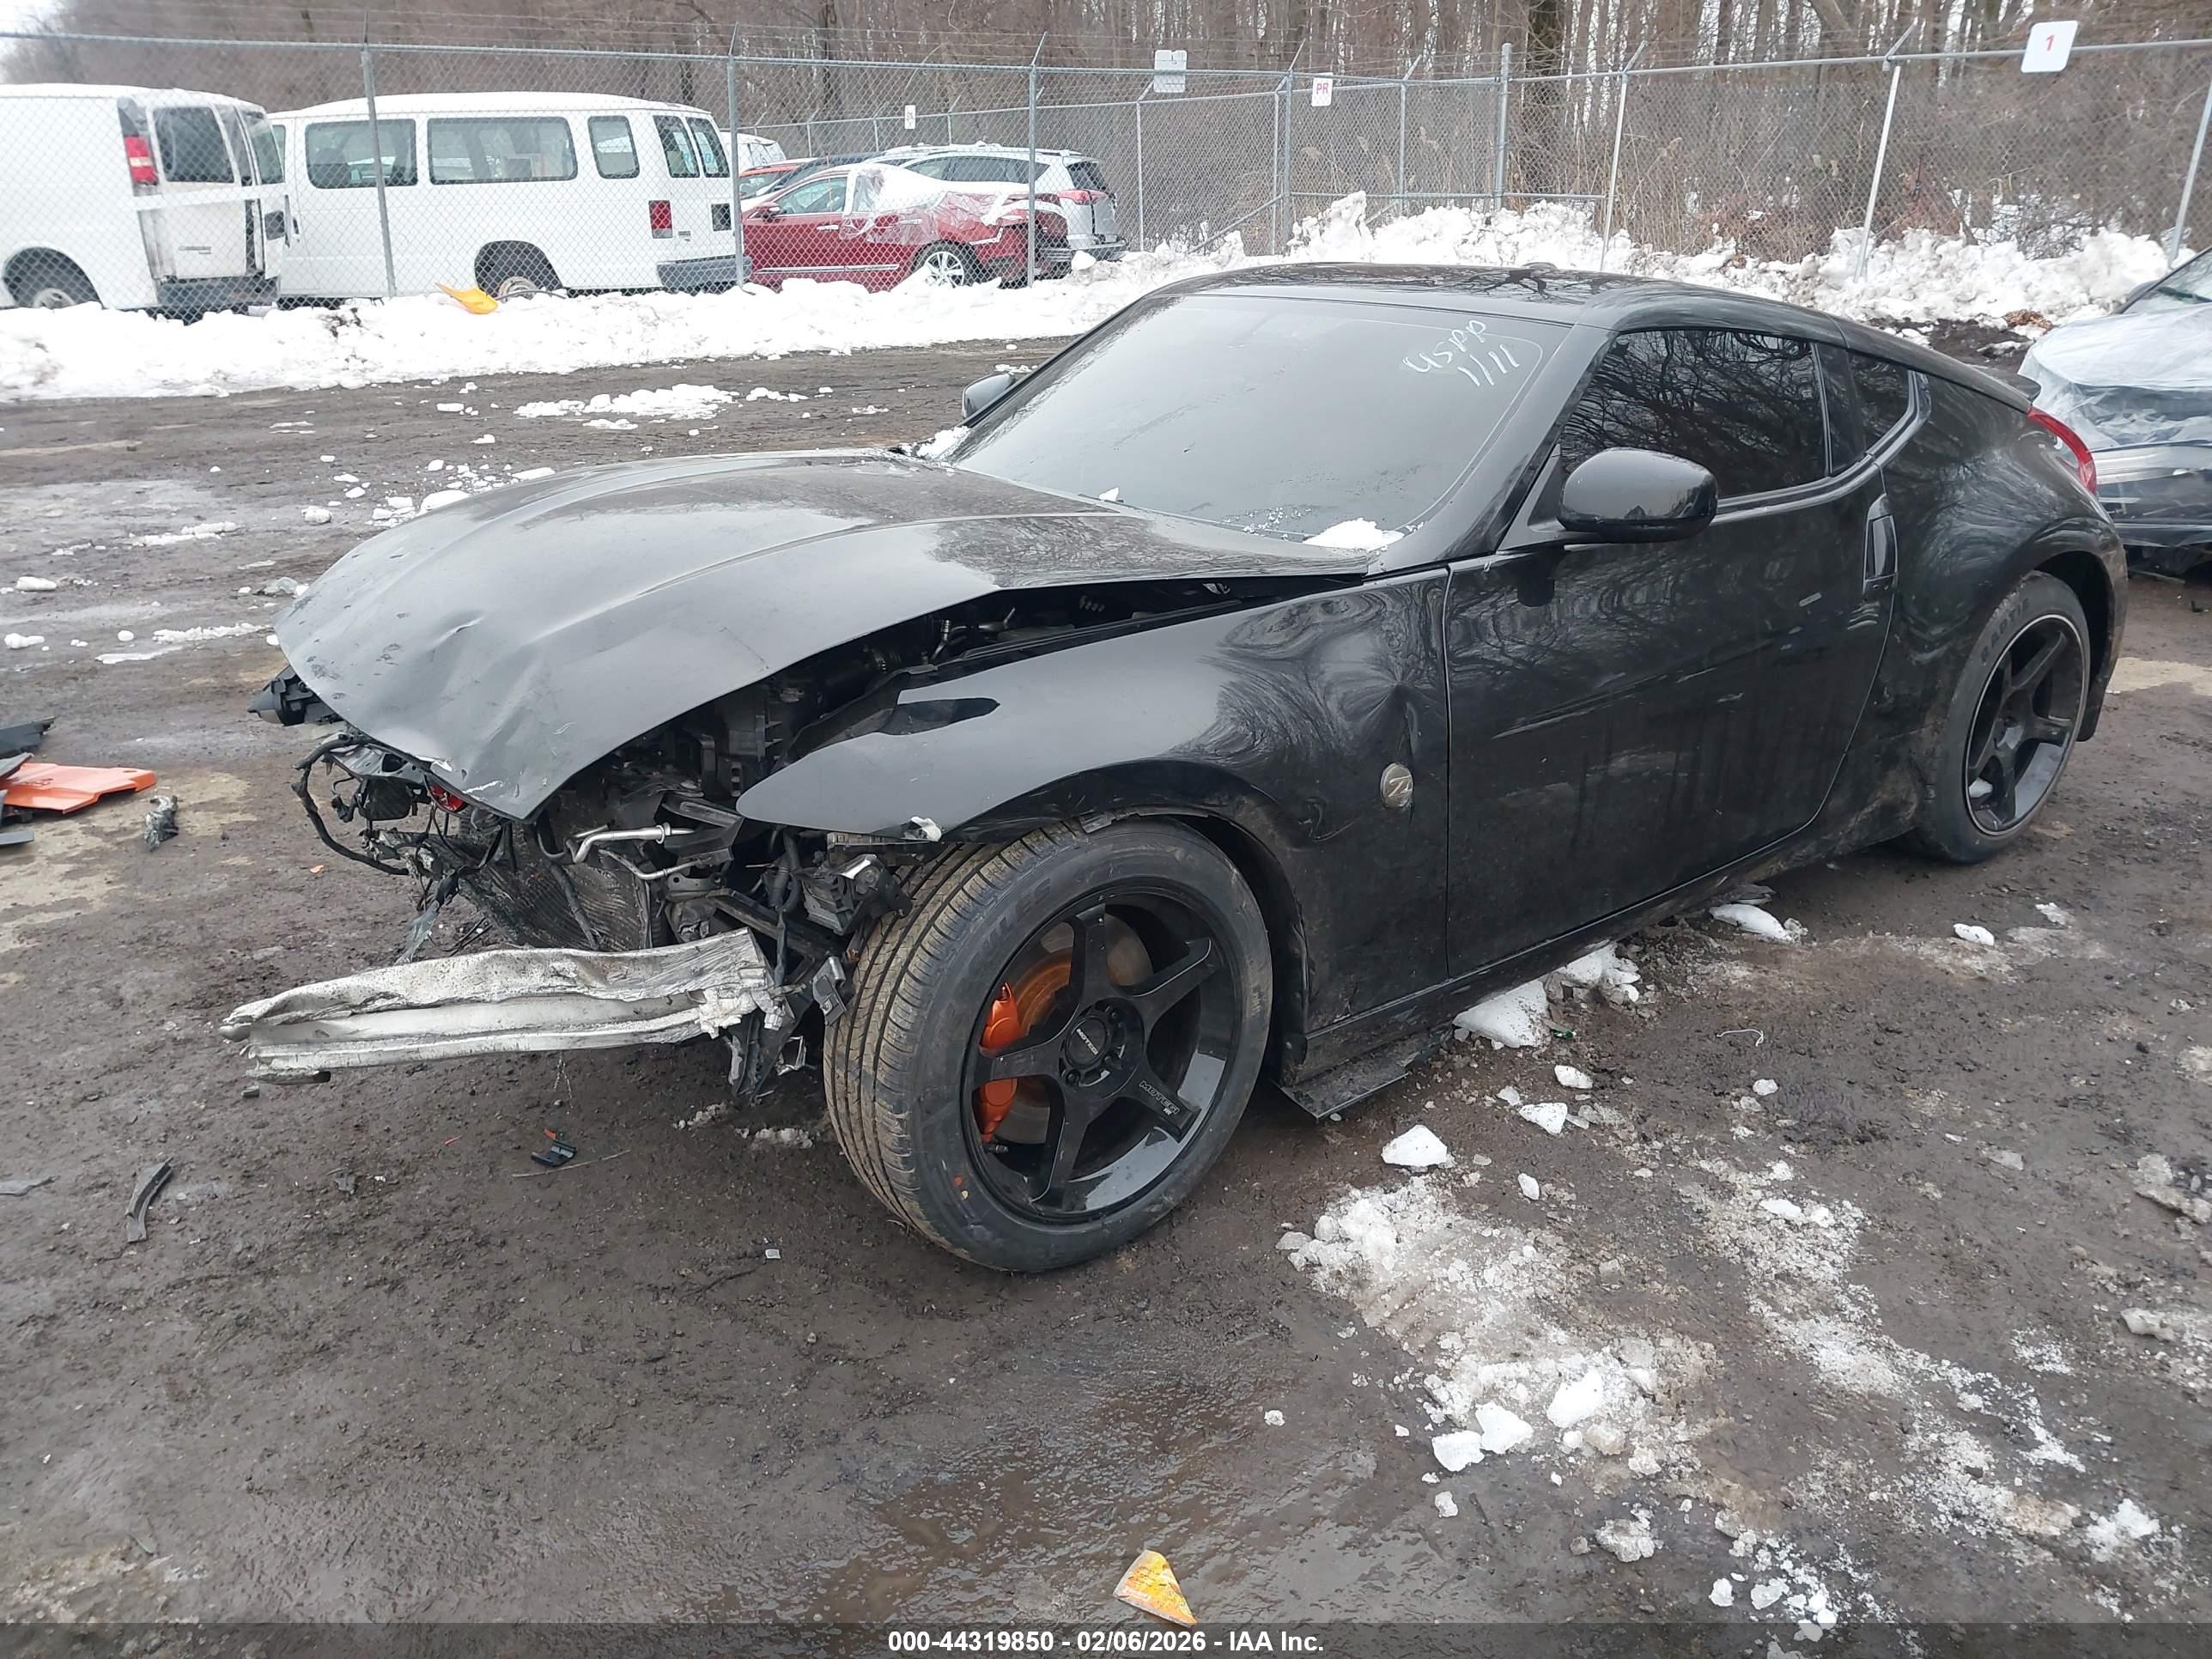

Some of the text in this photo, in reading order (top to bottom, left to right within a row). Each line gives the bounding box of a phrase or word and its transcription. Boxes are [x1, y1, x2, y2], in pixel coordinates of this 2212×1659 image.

[2045, 33, 2056, 52] 1
[1316, 82, 1329, 95] PR
[1076, 1028, 1099, 1055] MOTEGI
[1139, 1080, 1180, 1115] MOTEGI
